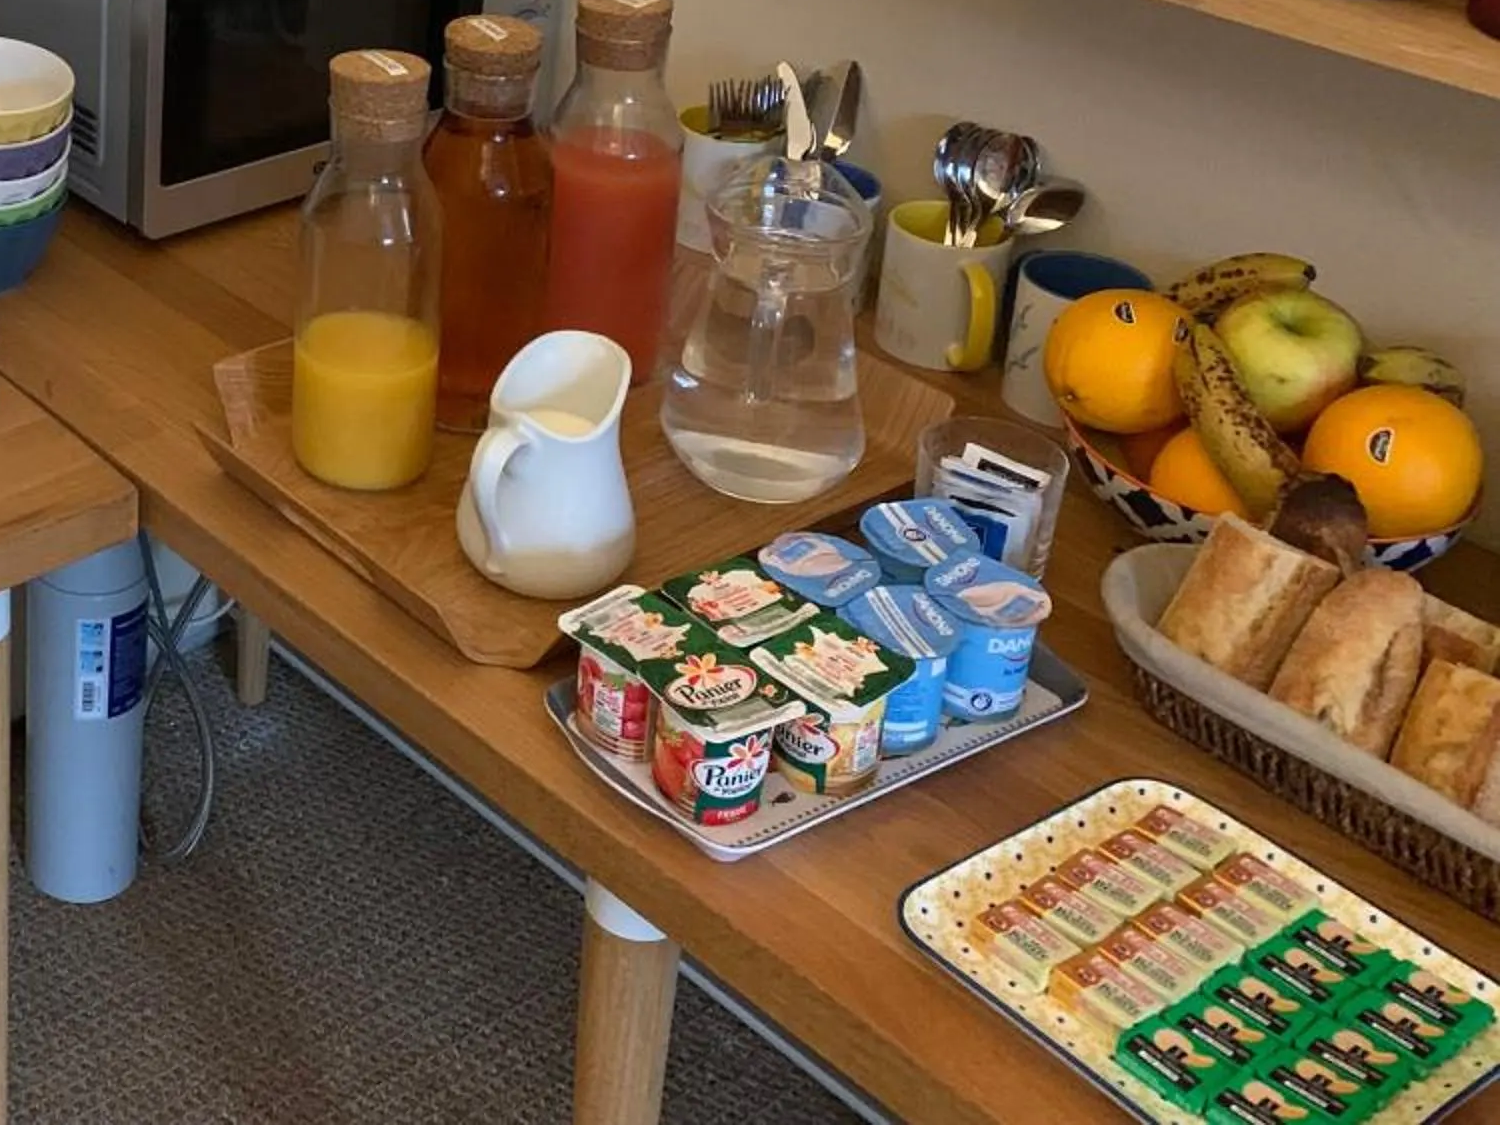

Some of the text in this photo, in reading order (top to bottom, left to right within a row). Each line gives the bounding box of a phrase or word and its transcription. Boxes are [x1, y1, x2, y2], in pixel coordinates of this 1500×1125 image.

[675, 678, 741, 704] Panier
[776, 723, 824, 756] anier
[703, 763, 764, 787] Panier
